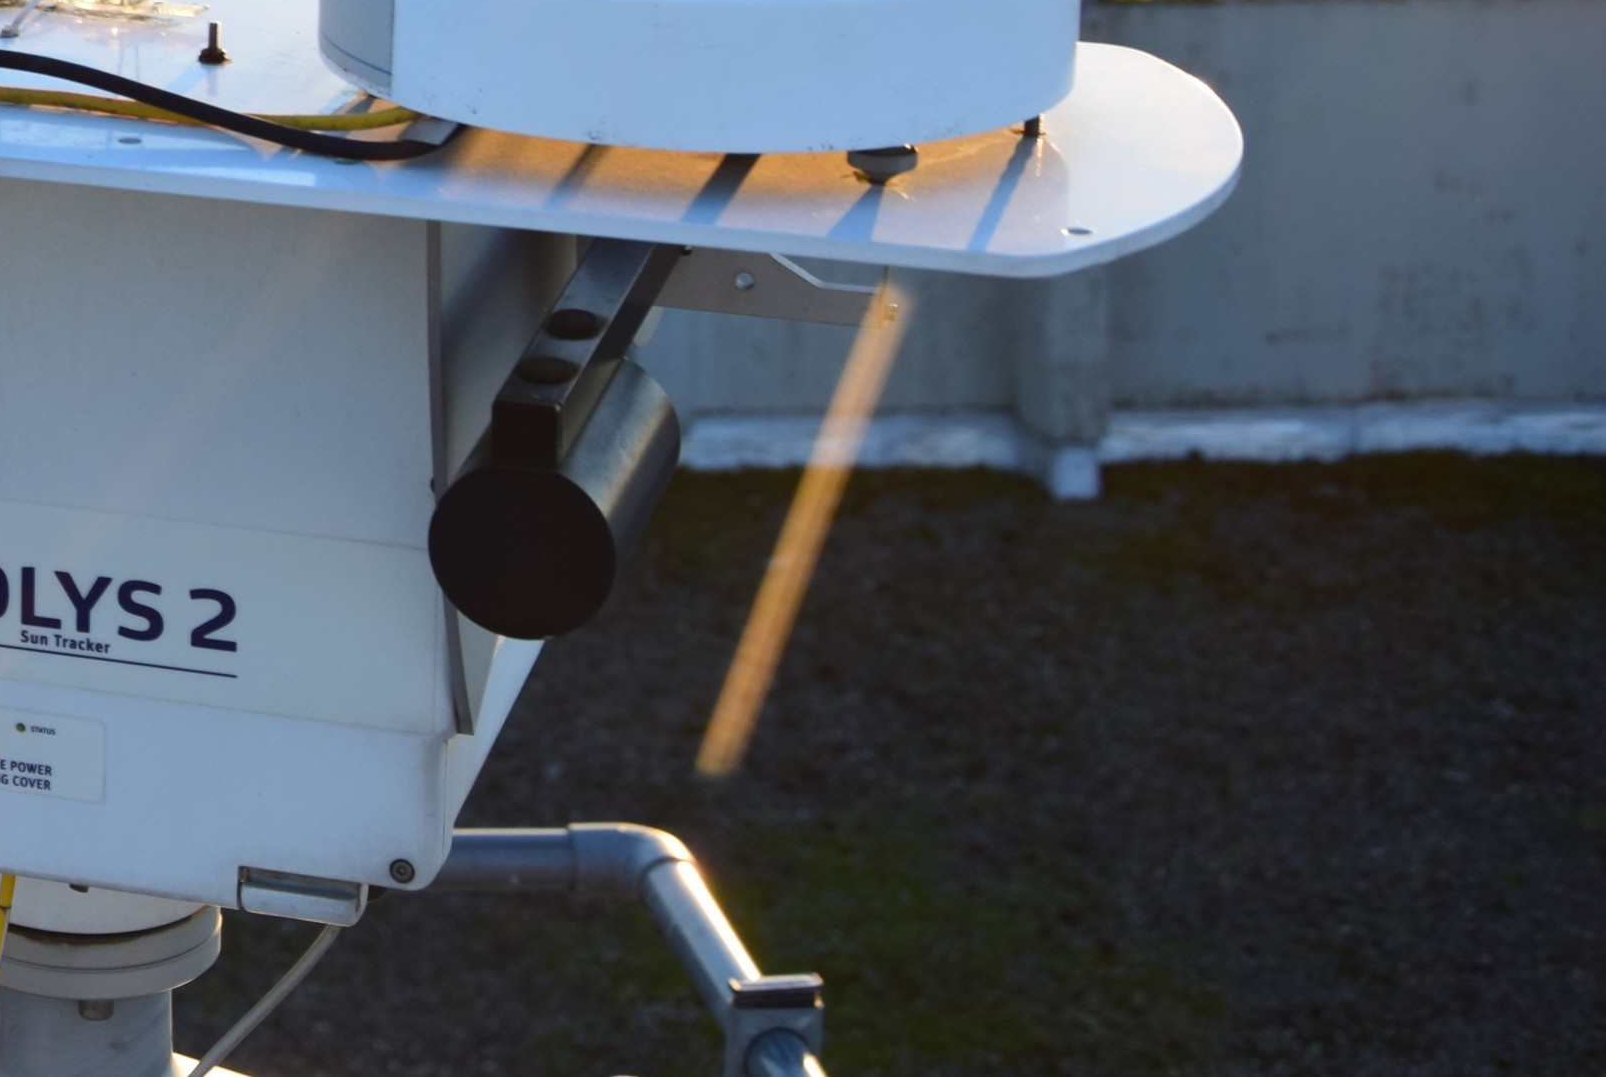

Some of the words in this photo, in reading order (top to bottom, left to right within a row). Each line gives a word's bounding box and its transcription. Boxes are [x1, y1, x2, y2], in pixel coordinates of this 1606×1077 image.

[189, 588, 237, 652] 2
[20, 630, 49, 646] Sun
[53, 634, 111, 654] Tracker
[31, 726, 56, 735] STATUS
[10, 761, 52, 776] POWER
[13, 776, 51, 790] COVER
